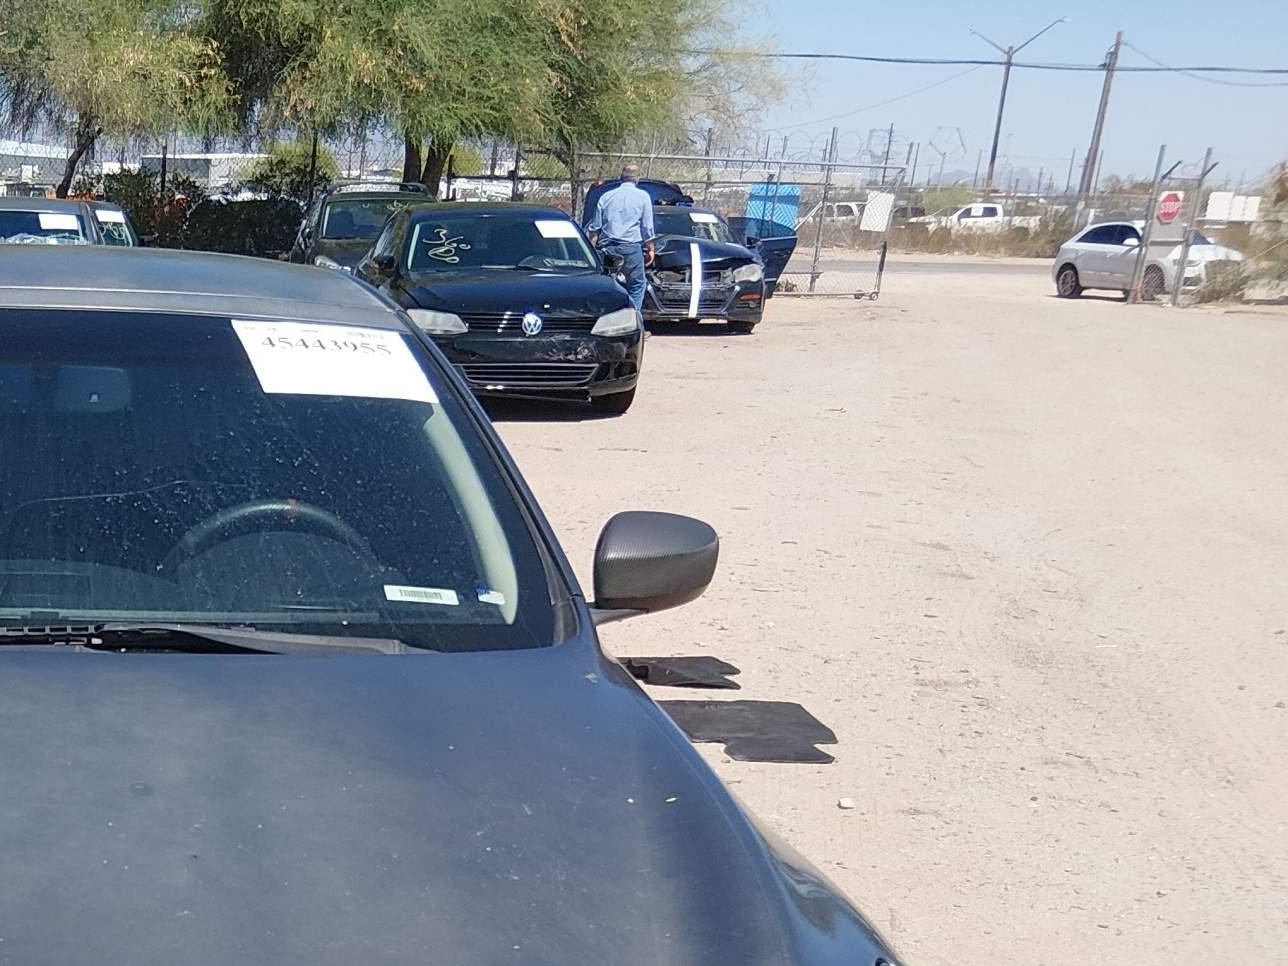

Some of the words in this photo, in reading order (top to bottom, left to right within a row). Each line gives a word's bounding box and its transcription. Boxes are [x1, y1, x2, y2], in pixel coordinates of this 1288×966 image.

[1160, 201, 1183, 213] STOP
[422, 228, 472, 250] 360
[262, 336, 393, 355] 45443955
